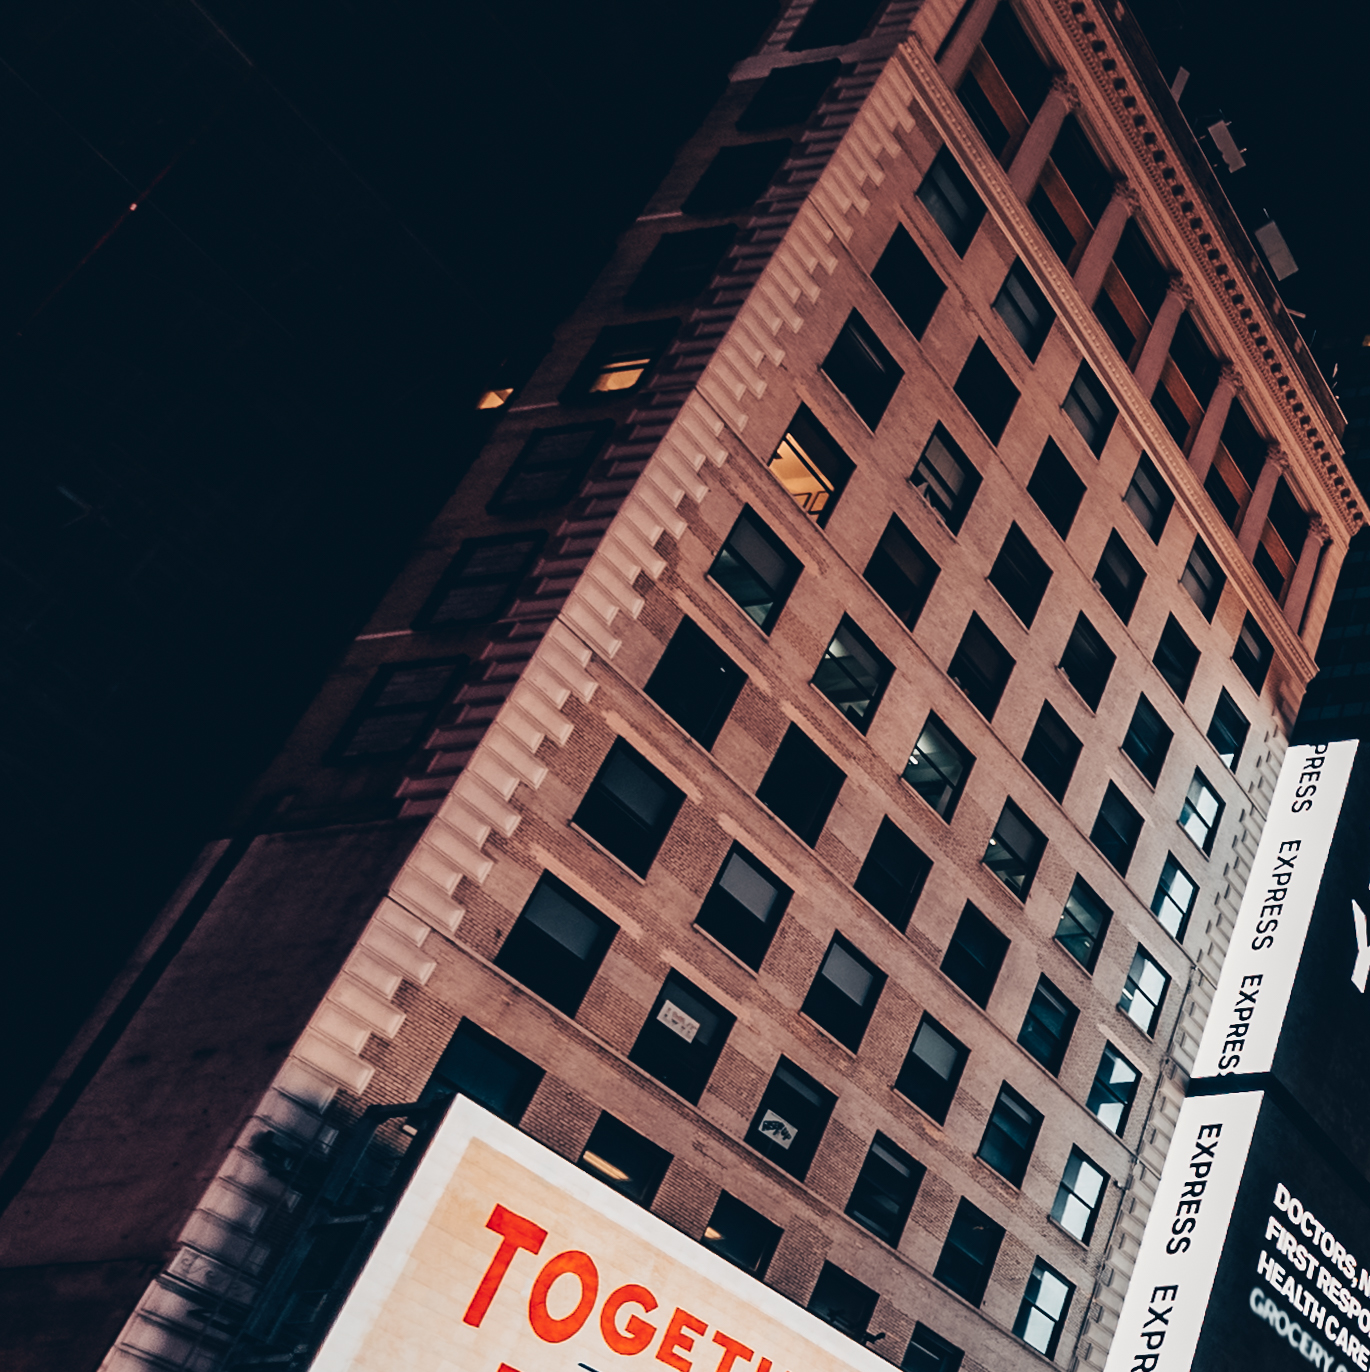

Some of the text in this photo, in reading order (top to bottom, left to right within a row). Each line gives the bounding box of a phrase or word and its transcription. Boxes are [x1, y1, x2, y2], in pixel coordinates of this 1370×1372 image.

[1252, 838, 1301, 952] EXPRESS
[1166, 1122, 1224, 1257] EXPRESS
[1273, 1182, 1358, 1286] DOCTORS,
[1256, 1250, 1327, 1331] HEALTH
[1264, 1216, 1319, 1281] FIRST
